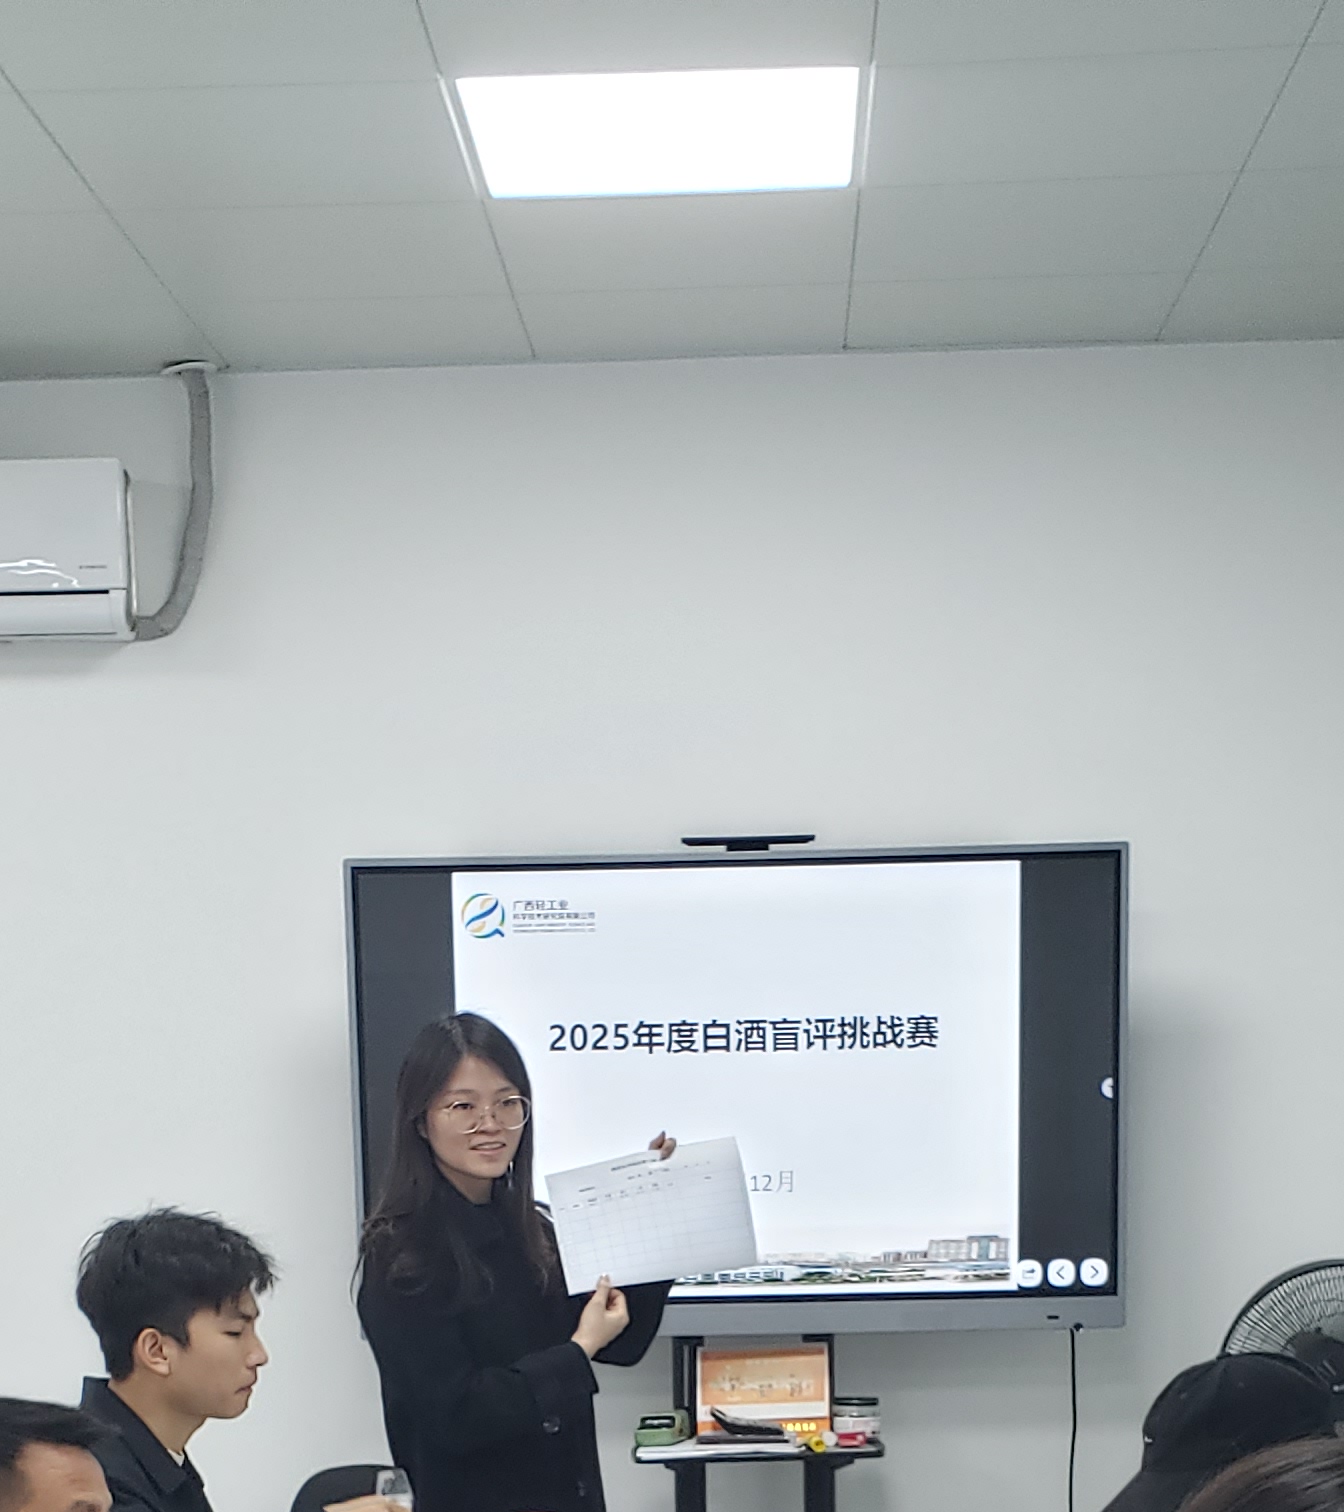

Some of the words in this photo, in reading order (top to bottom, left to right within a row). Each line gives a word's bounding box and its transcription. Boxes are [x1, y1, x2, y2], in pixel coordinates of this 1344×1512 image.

[513, 900, 570, 911] 广西轻工业
[548, 1014, 940, 1055] 2025年度白酒盲评挑战赛
[749, 1170, 794, 1193] 12月
